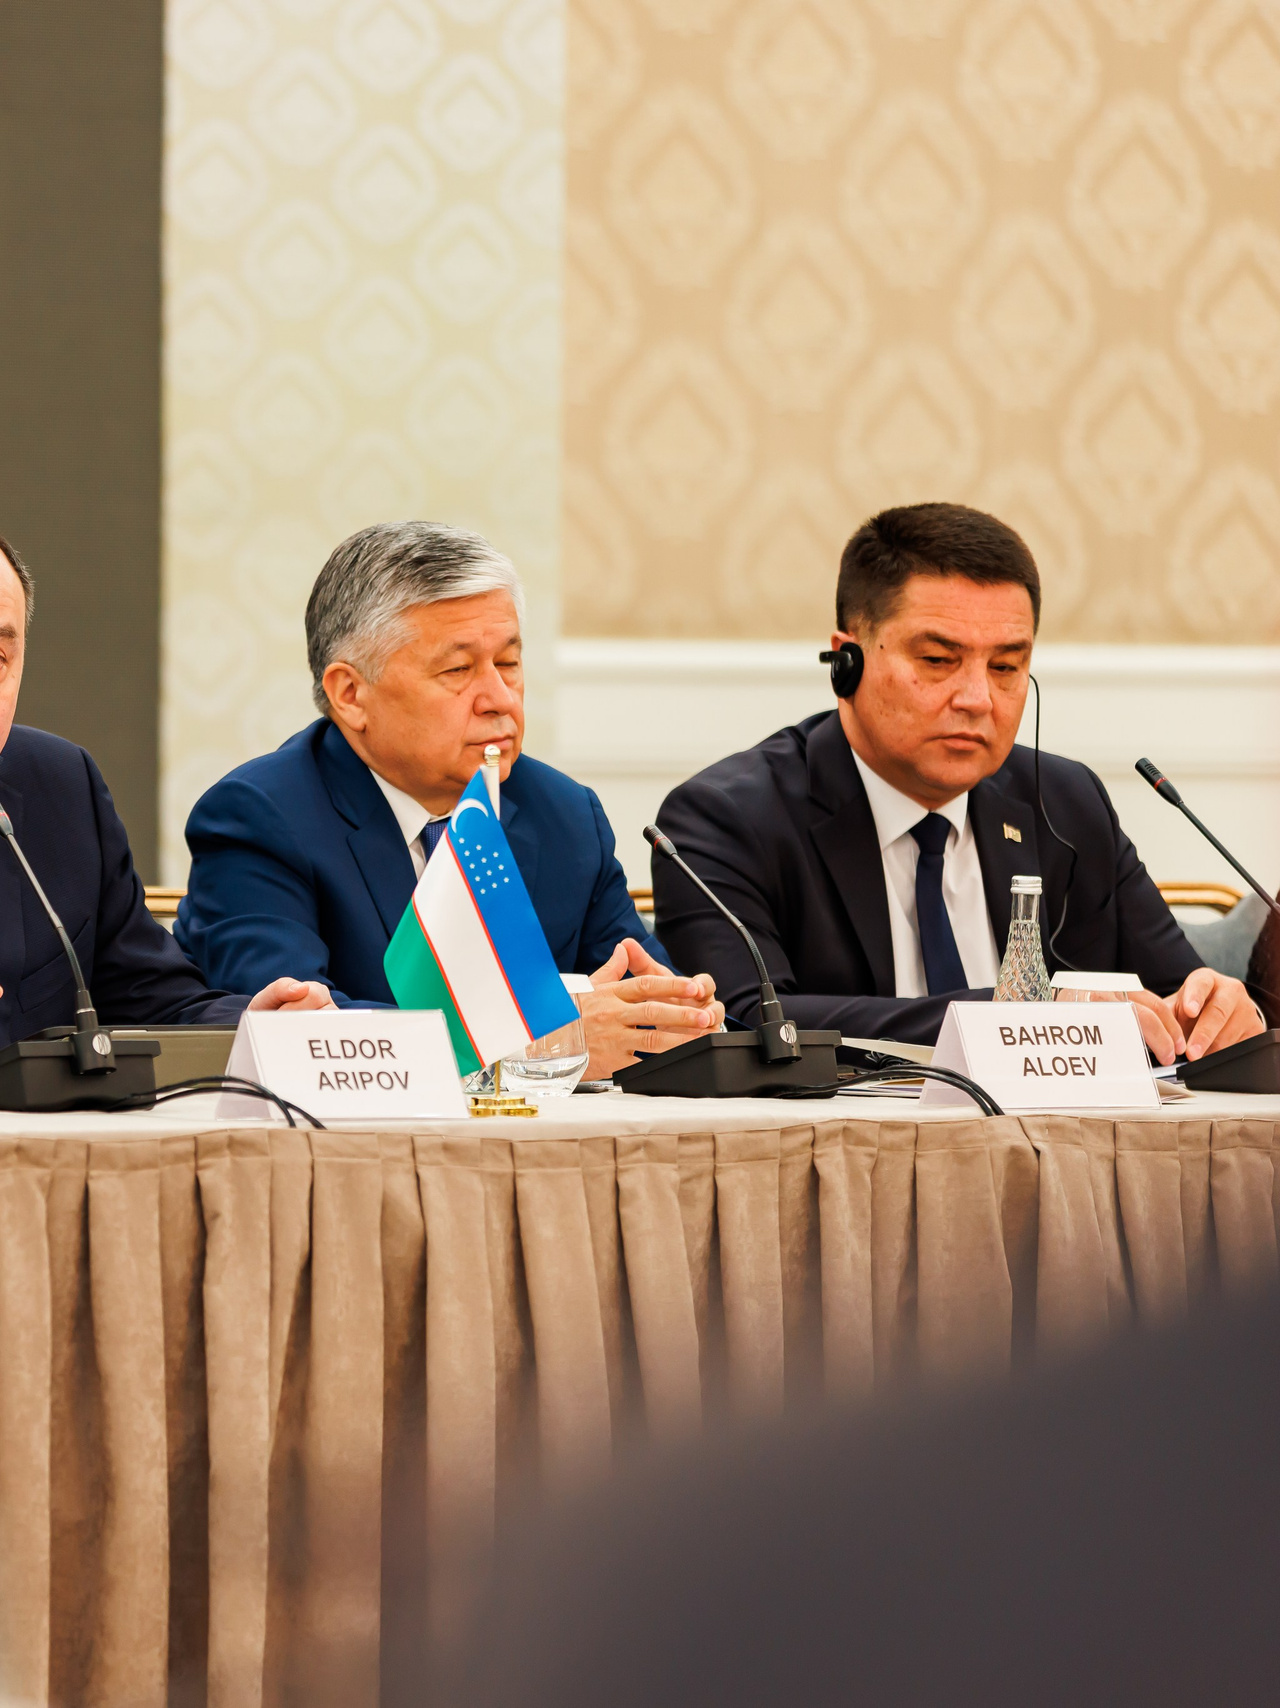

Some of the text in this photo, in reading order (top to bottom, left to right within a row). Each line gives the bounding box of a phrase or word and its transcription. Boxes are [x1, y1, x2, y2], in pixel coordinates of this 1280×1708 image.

[997, 1025, 1104, 1046] BAHROM
[308, 1039, 397, 1060] ELDOR
[1022, 1056, 1097, 1077] ALOEV
[318, 1071, 410, 1090] ARIPOV
